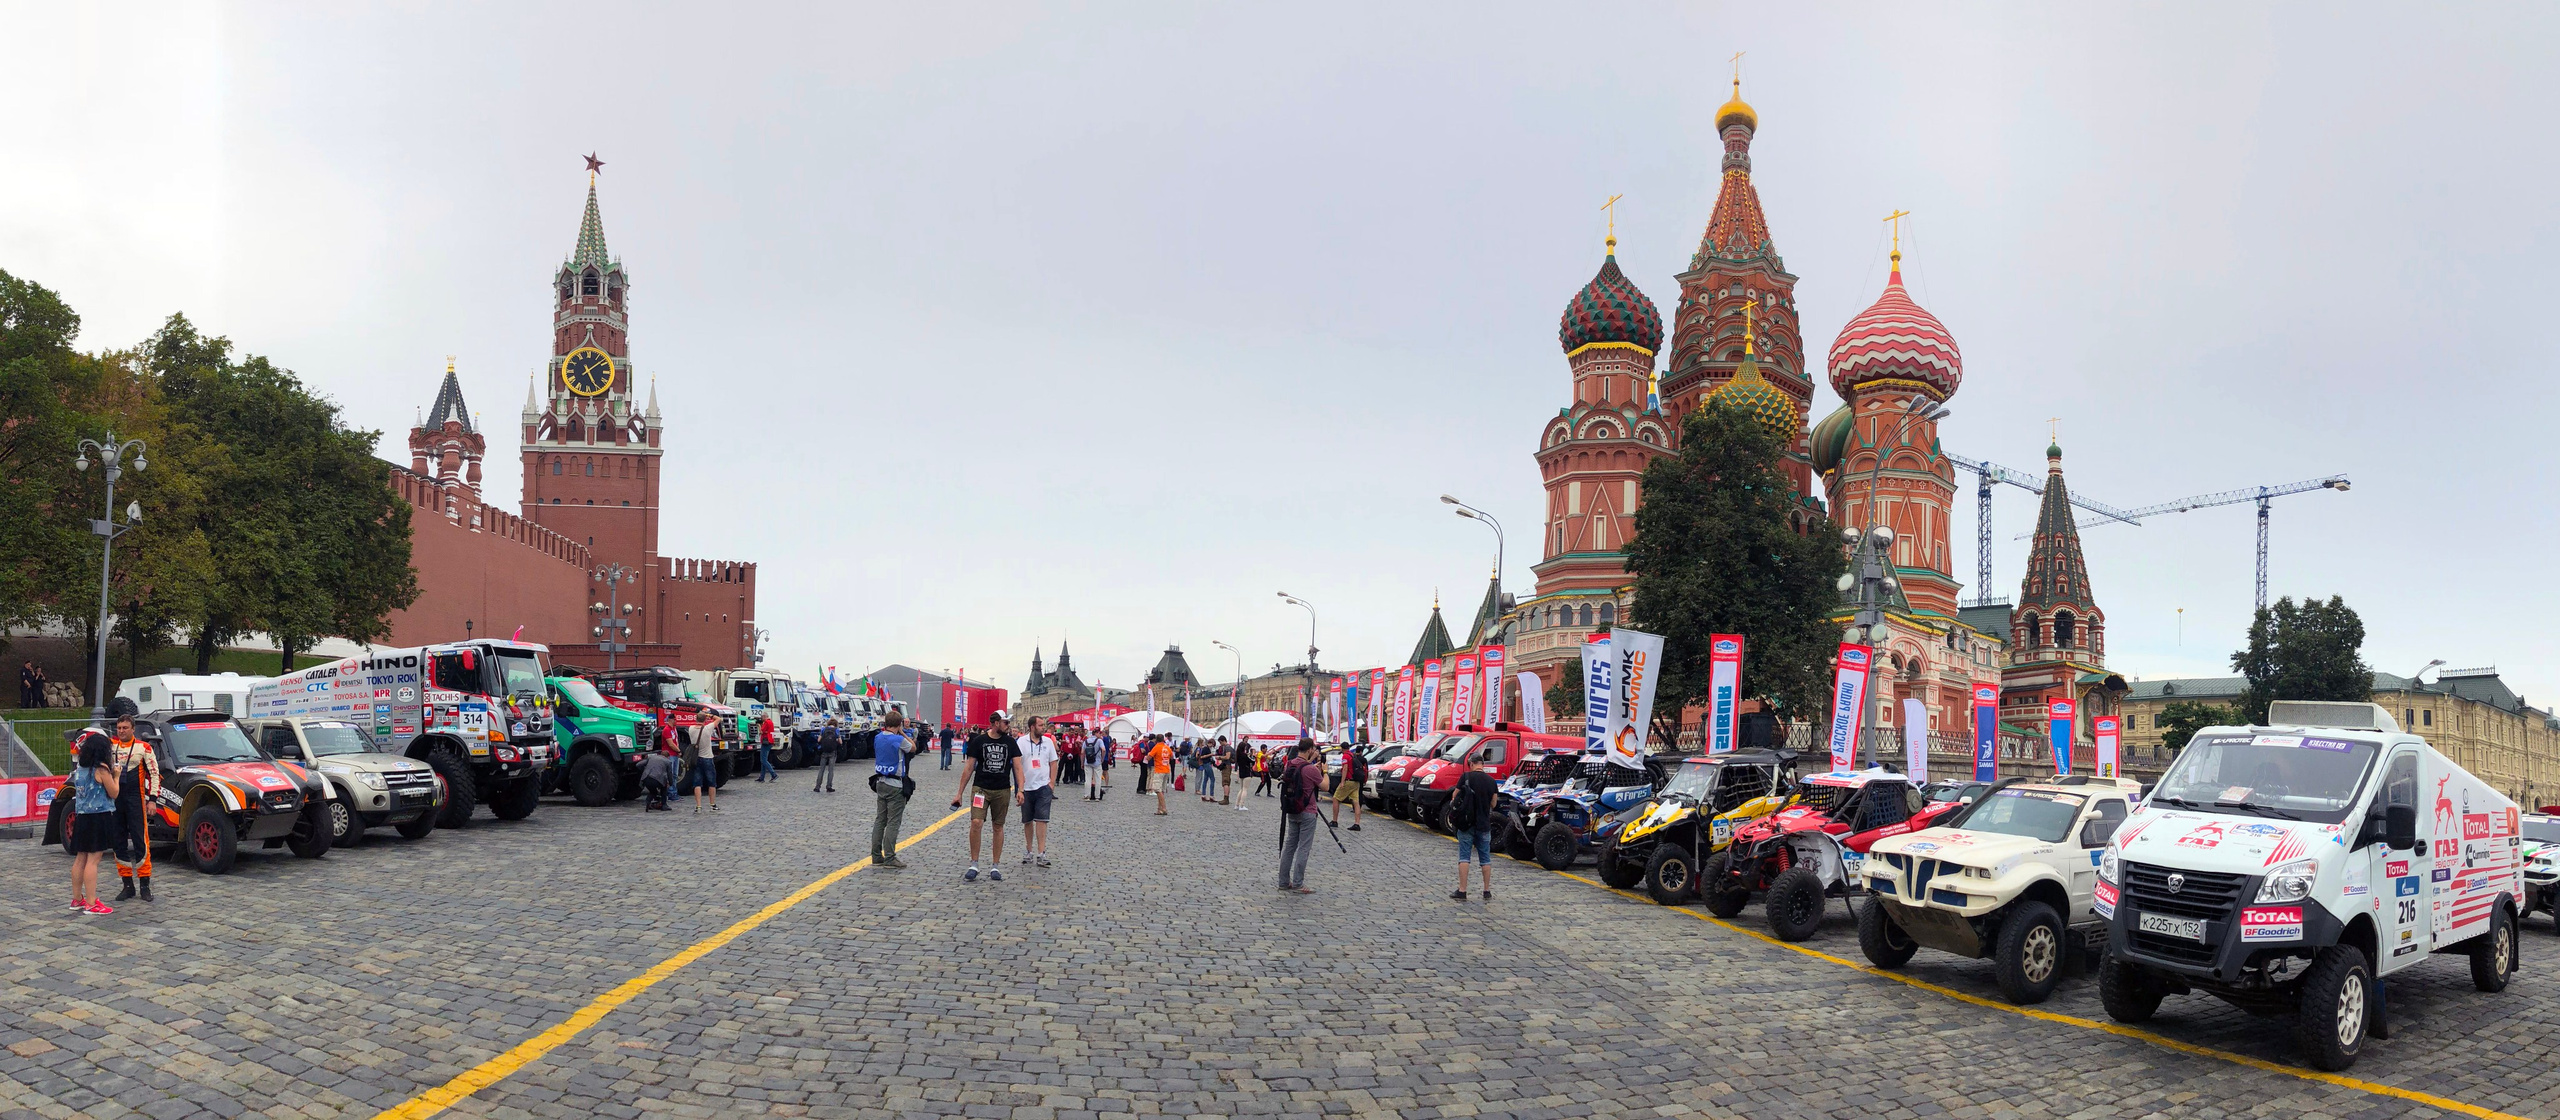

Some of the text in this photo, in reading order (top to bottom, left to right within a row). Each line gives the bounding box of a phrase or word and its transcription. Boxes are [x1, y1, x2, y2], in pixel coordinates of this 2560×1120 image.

[361, 656, 418, 671] HINO
[305, 668, 338, 680] CATALER
[366, 673, 417, 686] TOKYO ROKI
[280, 677, 303, 686] DENSO
[307, 682, 329, 692] CTC
[341, 679, 363, 687] IDEMITSU
[1629, 650, 1646, 722] UMMC
[374, 689, 391, 698] NPR
[433, 693, 460, 702] TACHI-S
[463, 713, 483, 725] 314
[2308, 739, 2336, 748] ИЗВЕСТИЯ
[1624, 788, 1647, 800] Fores
[2464, 818, 2489, 835] TOTAL
[2178, 836, 2220, 848] ГАЗ
[2435, 838, 2458, 859] ГАЗ
[2473, 849, 2490, 861] Cummins
[1848, 861, 1861, 871] 115
[2387, 864, 2408, 876] TOTAL
[2467, 877, 2488, 889] BFGoodrich
[2096, 881, 2116, 903] TOTAL
[2343, 885, 2368, 894] BFGoodrich
[2244, 910, 2300, 923] TOTAL
[2398, 899, 2416, 924] 216
[2183, 922, 2199, 933] 152
[2244, 927, 2300, 936] BFGoodrich
